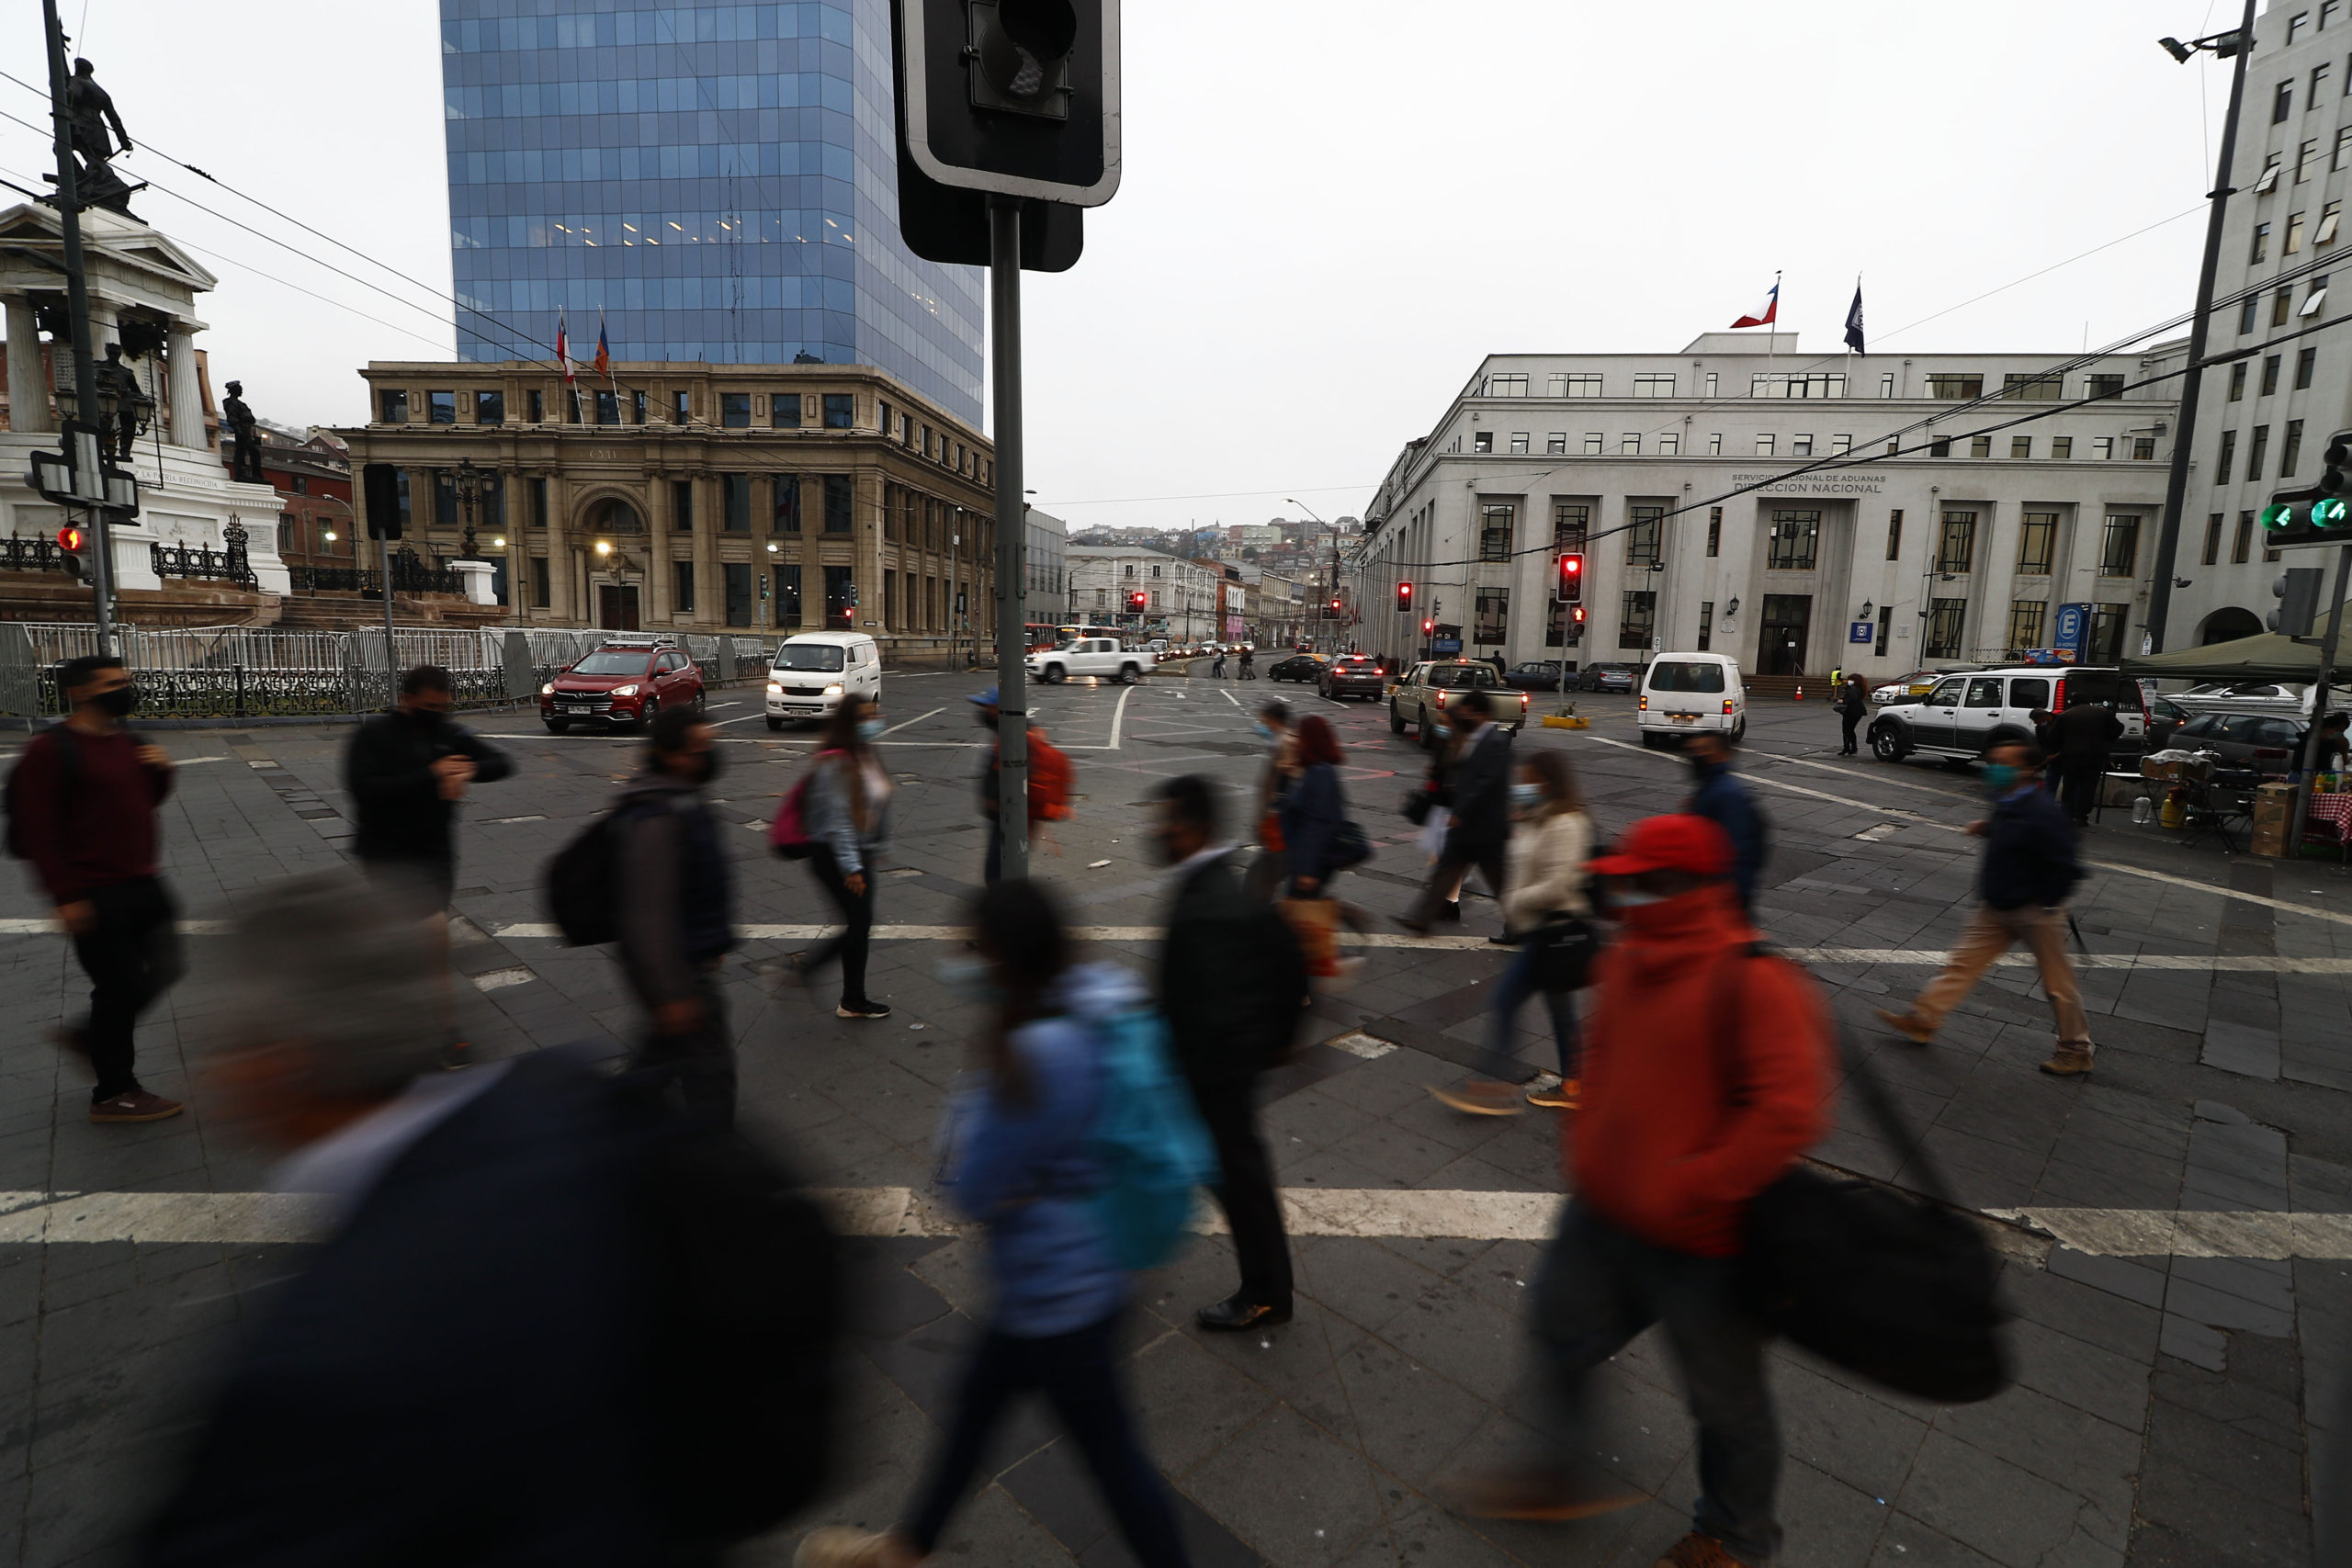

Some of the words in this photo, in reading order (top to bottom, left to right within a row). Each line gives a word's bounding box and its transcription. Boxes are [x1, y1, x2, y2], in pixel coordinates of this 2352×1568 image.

[141, 469, 151, 479] LA
[1777, 474, 1824, 482] CIONAL
[1841, 475, 1886, 483] ADUANAS
[1812, 483, 1882, 493] NACIONAL
[2063, 614, 2076, 634] E
